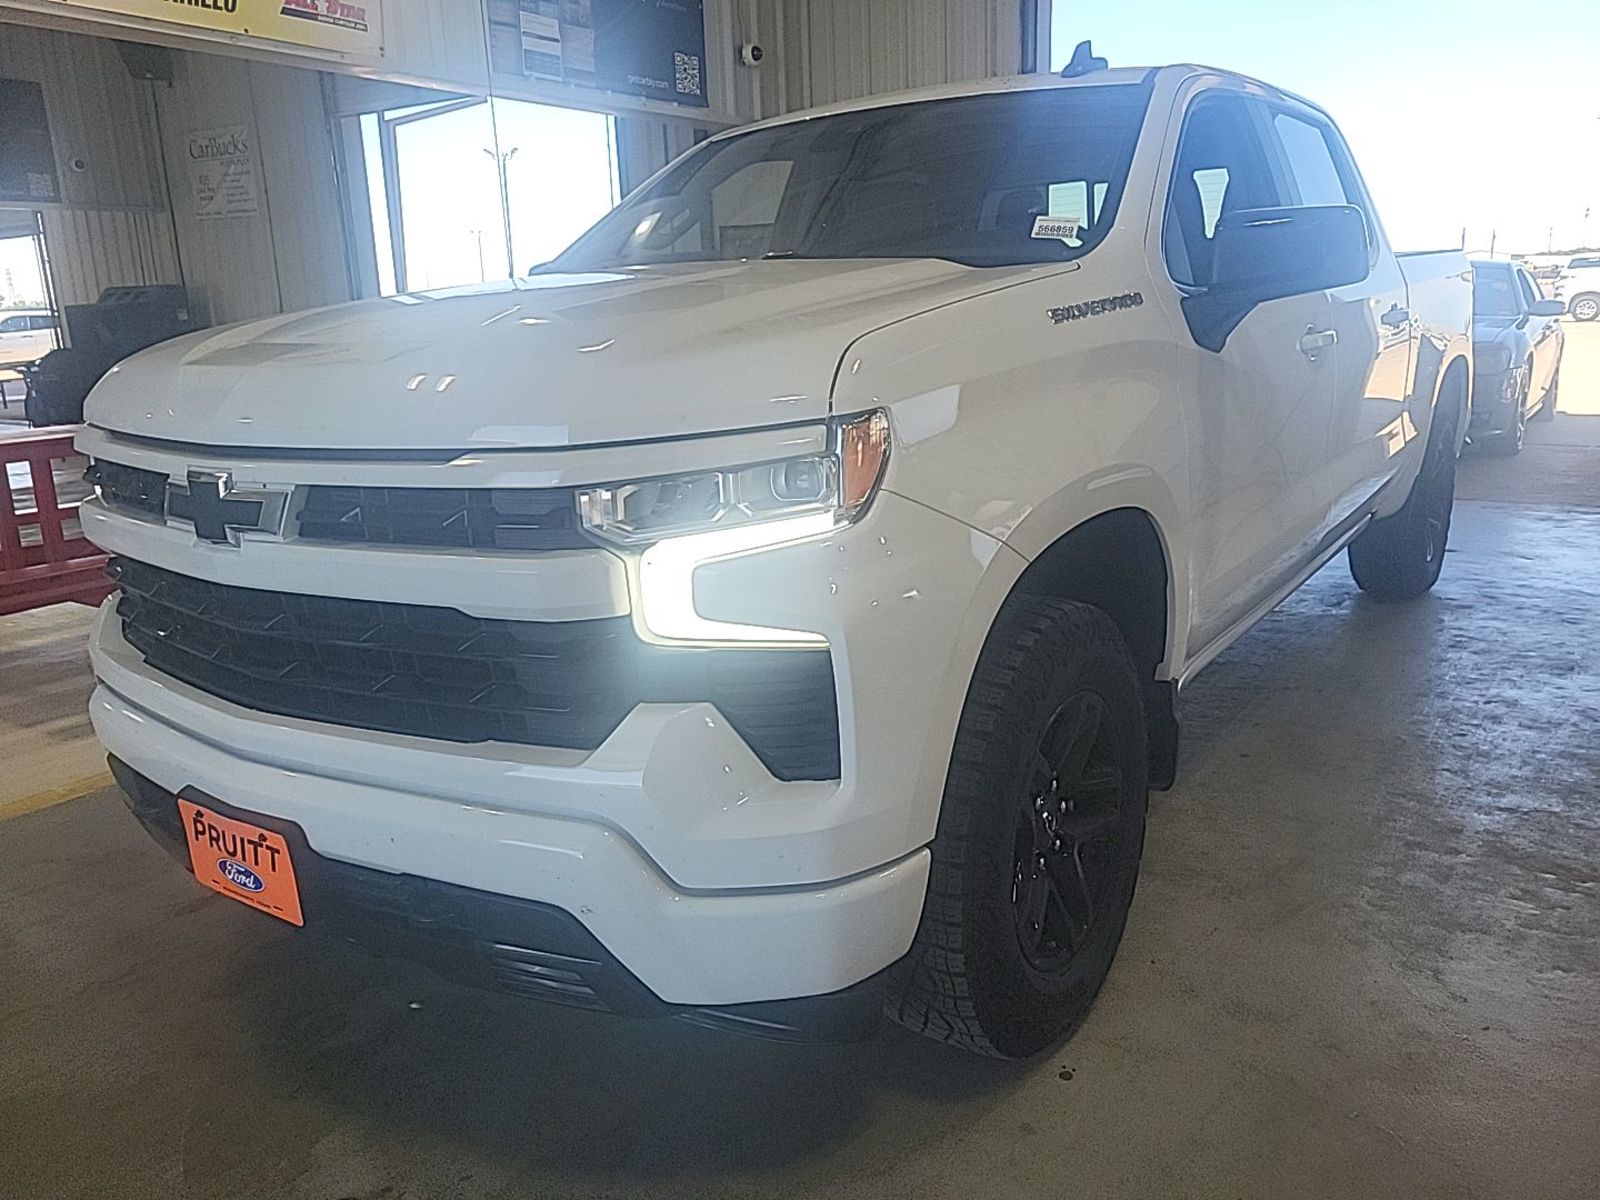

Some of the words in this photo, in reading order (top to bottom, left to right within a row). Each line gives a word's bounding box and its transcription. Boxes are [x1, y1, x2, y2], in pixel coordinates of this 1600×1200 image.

[189, 134, 249, 159] CarBucks
[1038, 224, 1074, 234] 566859
[1047, 292, 1143, 324] SILVERADO
[193, 816, 281, 873] PRUITT
[224, 860, 257, 889] Ford
